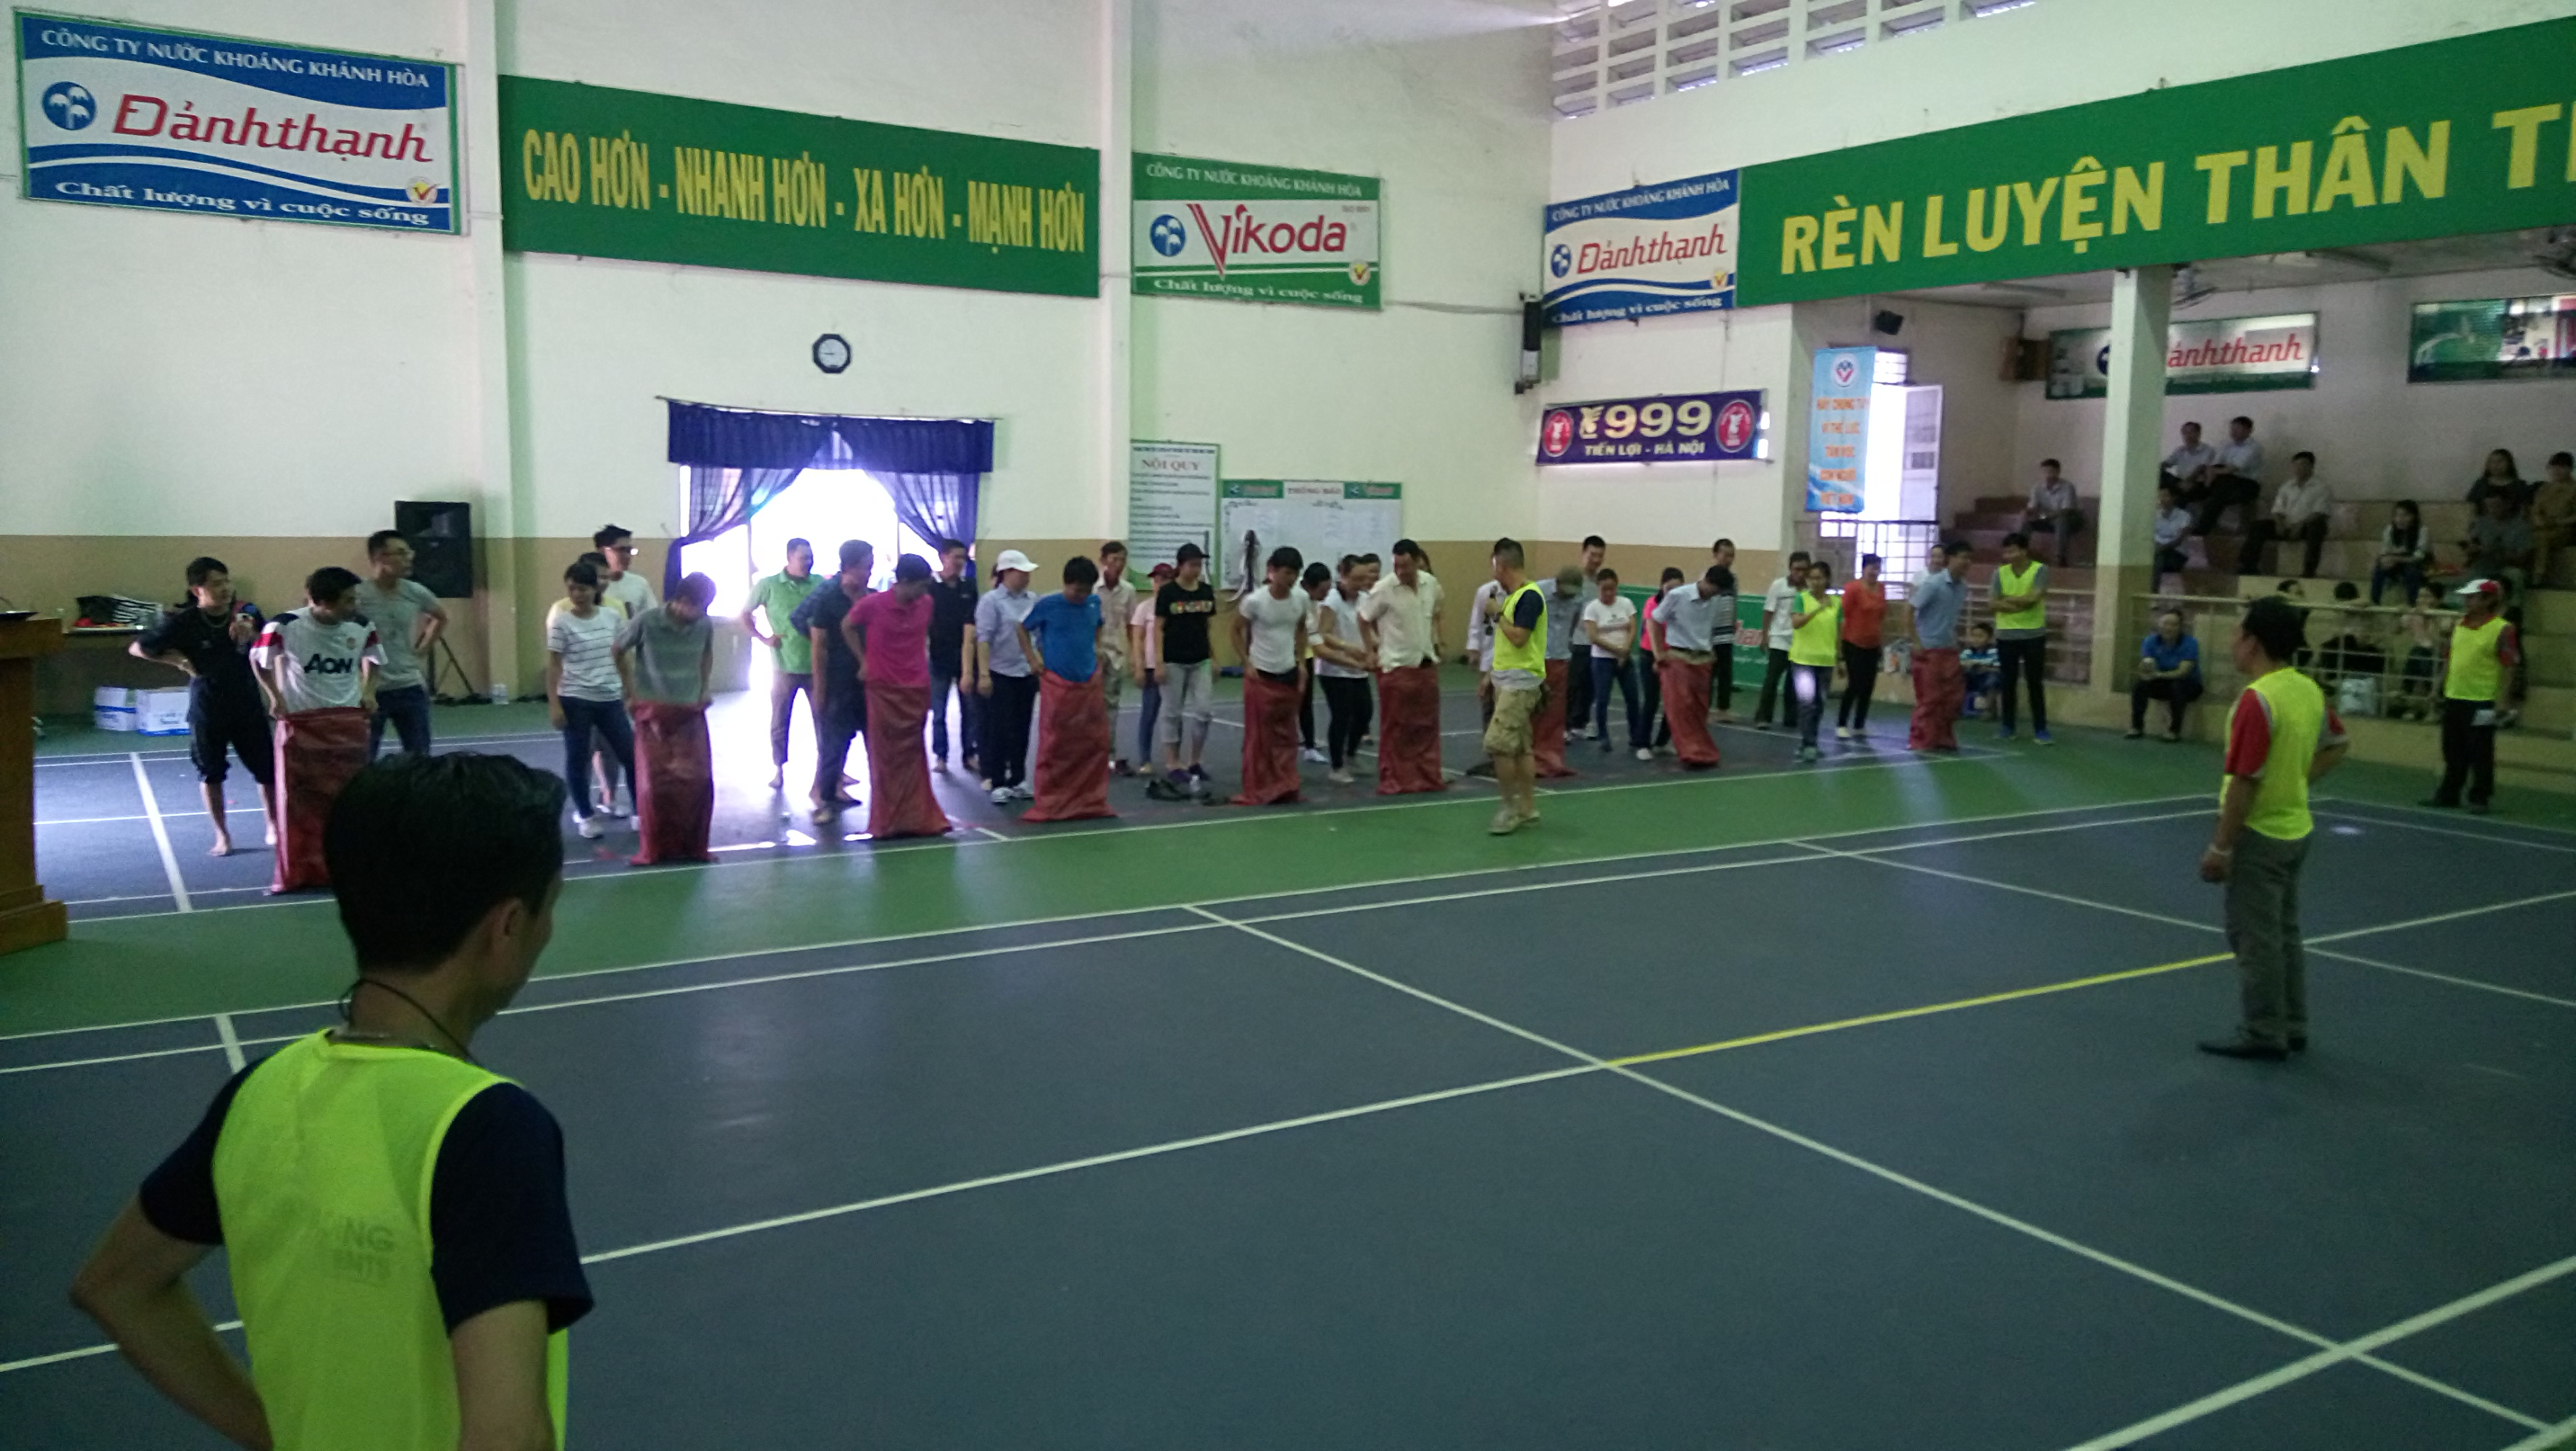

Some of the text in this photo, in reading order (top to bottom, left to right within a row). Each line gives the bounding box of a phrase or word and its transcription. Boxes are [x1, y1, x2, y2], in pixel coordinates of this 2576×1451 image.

[41, 28, 430, 87] CÔNG TY NƯỚC KHOÁNG KHÁNH HÒA
[55, 182, 430, 225] Chất lượng vì cuộc sống
[523, 129, 581, 203] CAO
[589, 129, 651, 210] HƠN
[674, 146, 766, 221] NHANH
[772, 150, 826, 228] HƠN
[853, 167, 887, 234] XA
[894, 165, 945, 239] HƠN
[967, 180, 1032, 254] MẠNH
[1039, 181, 1084, 253] HƠN
[1781, 195, 1904, 275] RÈN
[1923, 156, 2165, 258] LUYỆN
[2195, 115, 2450, 224] THÂN
[1186, 203, 1346, 277] Vikoda
[304, 653, 354, 674] AON
